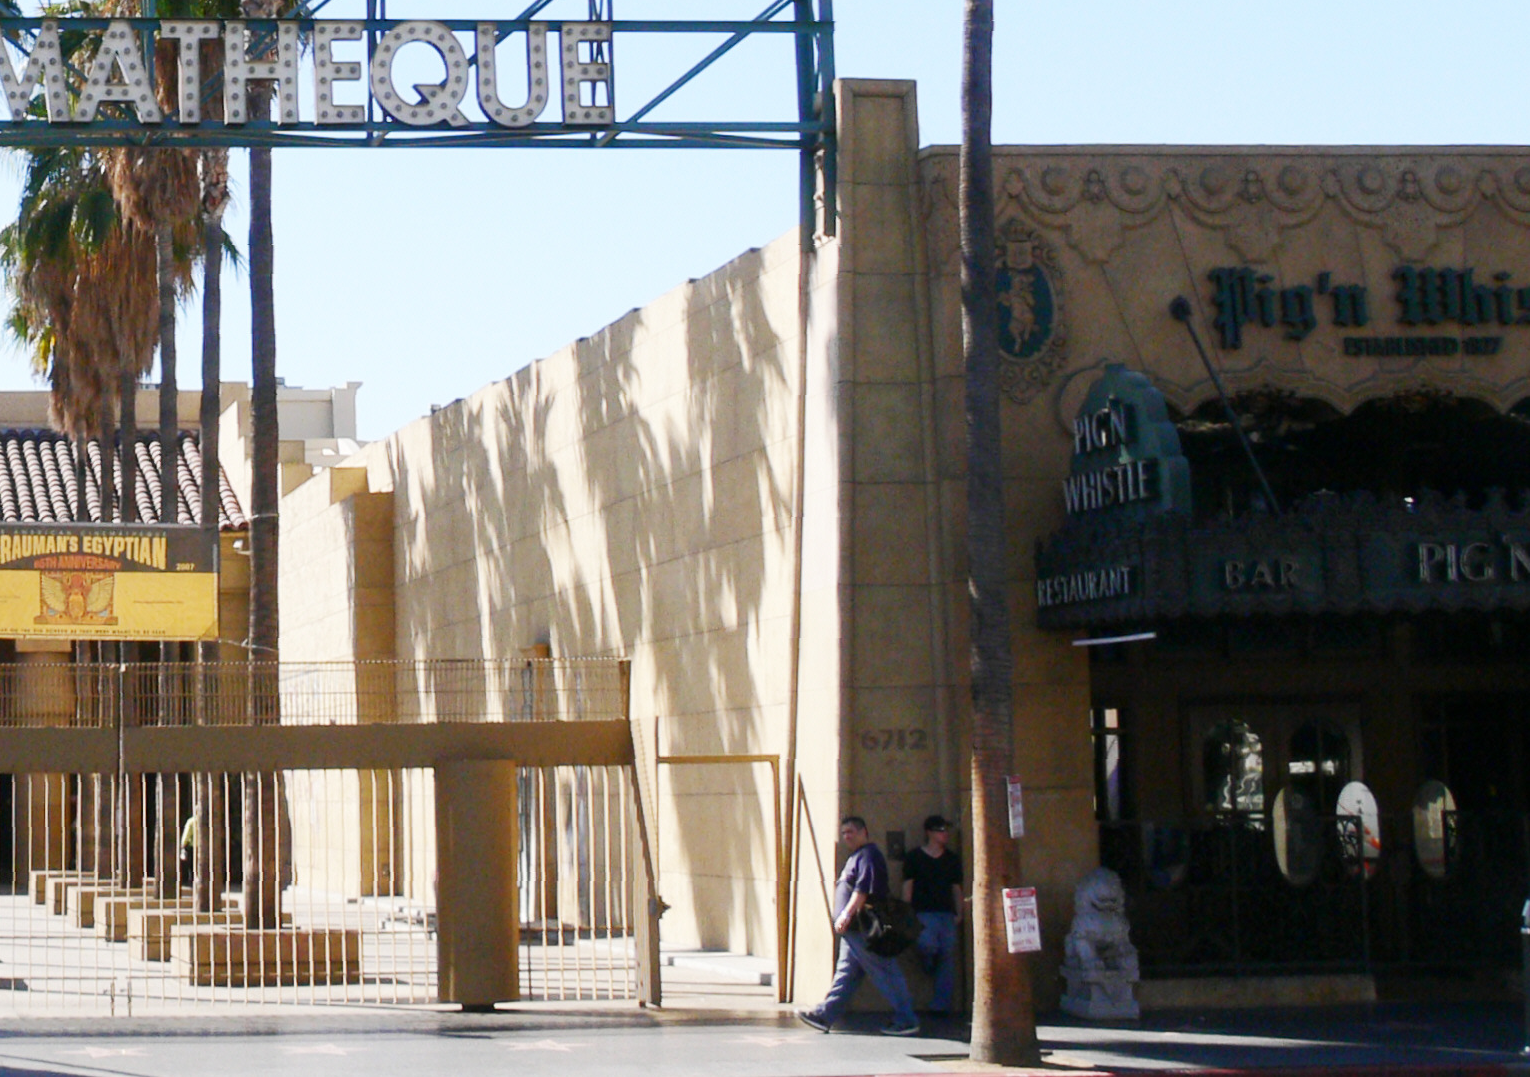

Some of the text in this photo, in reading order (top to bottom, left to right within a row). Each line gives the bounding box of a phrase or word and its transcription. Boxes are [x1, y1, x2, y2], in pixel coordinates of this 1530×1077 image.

[1062, 459, 1149, 515] WHISTLE
[58, 554, 121, 570] ANNIVERSARY
[83, 536, 168, 571] EGYPTIAN
[1037, 566, 1131, 607] RESTAURANT
[1224, 560, 1299, 589] BAR
[860, 729, 928, 751] 6712
